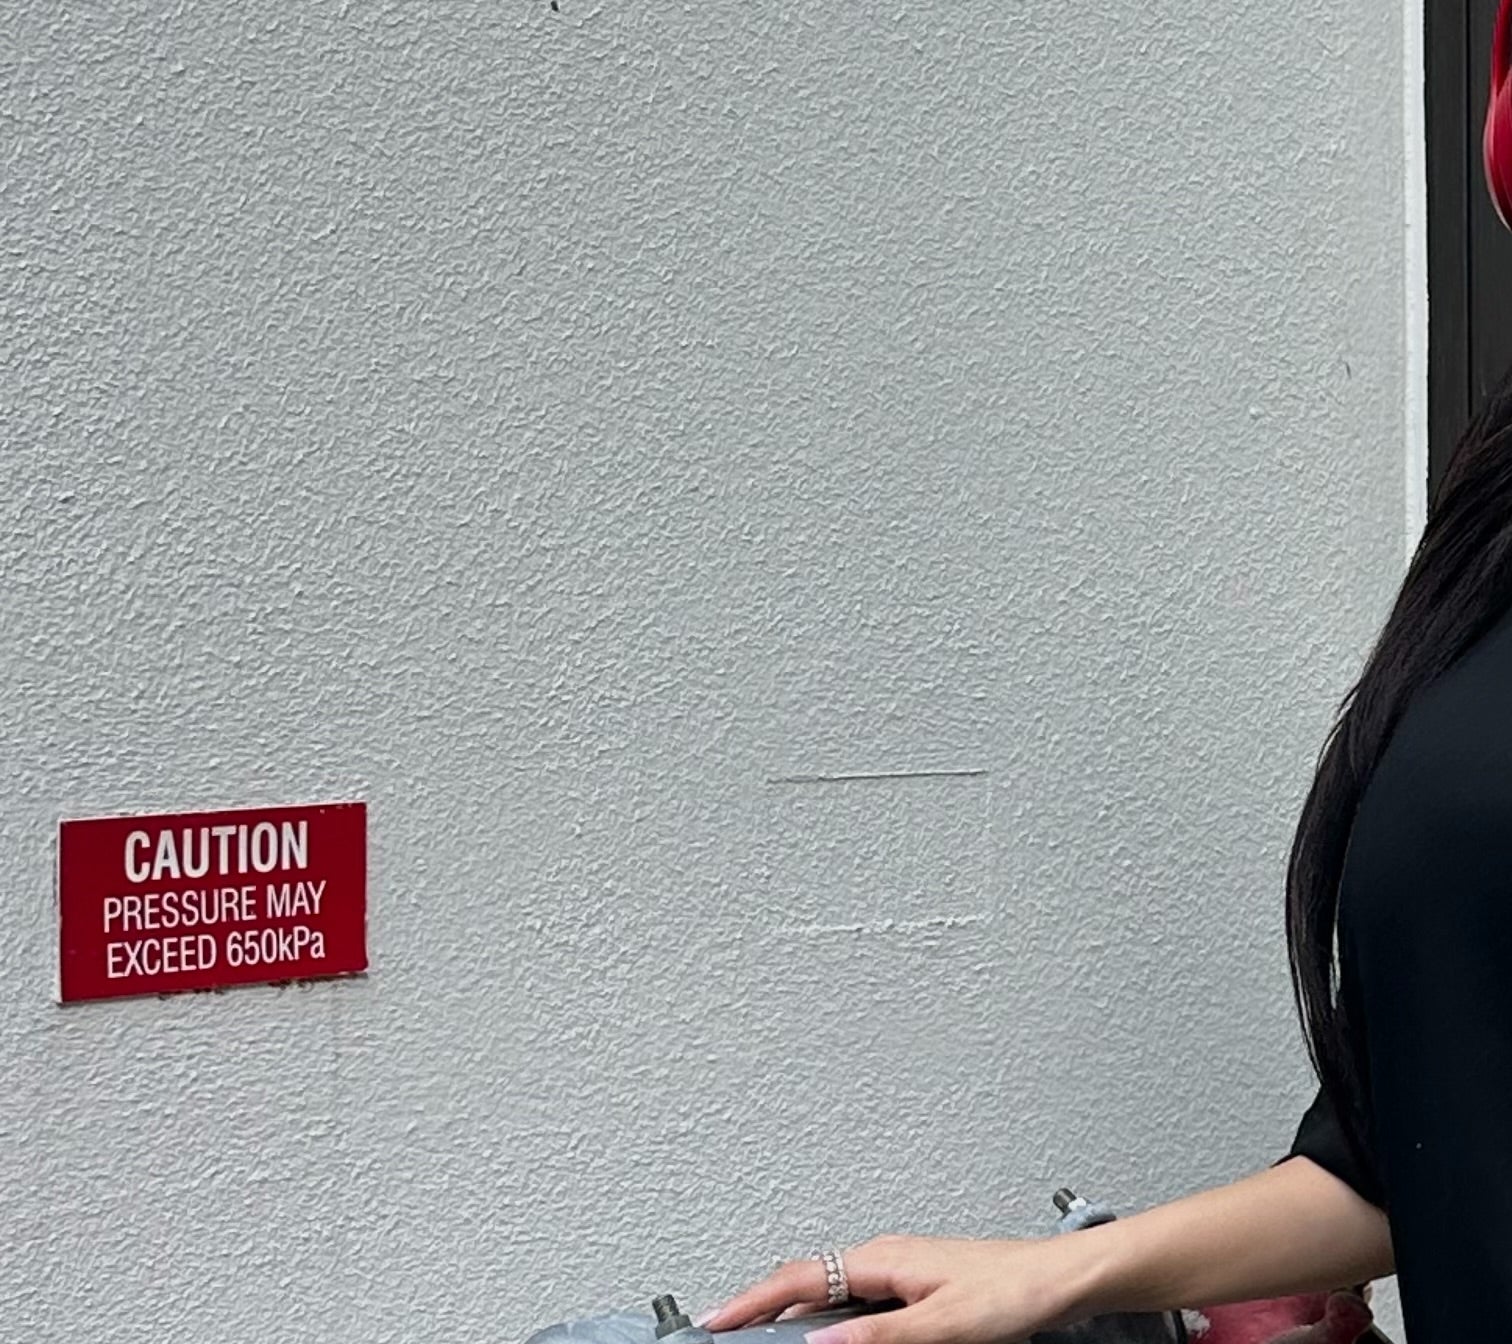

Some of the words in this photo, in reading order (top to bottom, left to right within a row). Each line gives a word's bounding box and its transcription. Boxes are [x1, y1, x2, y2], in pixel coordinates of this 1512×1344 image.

[124, 820, 309, 884] CAUTION
[103, 886, 257, 934] PRESSURE
[266, 880, 327, 919] MAY
[106, 934, 217, 979] EXCEED
[226, 925, 326, 968] 650kPa
